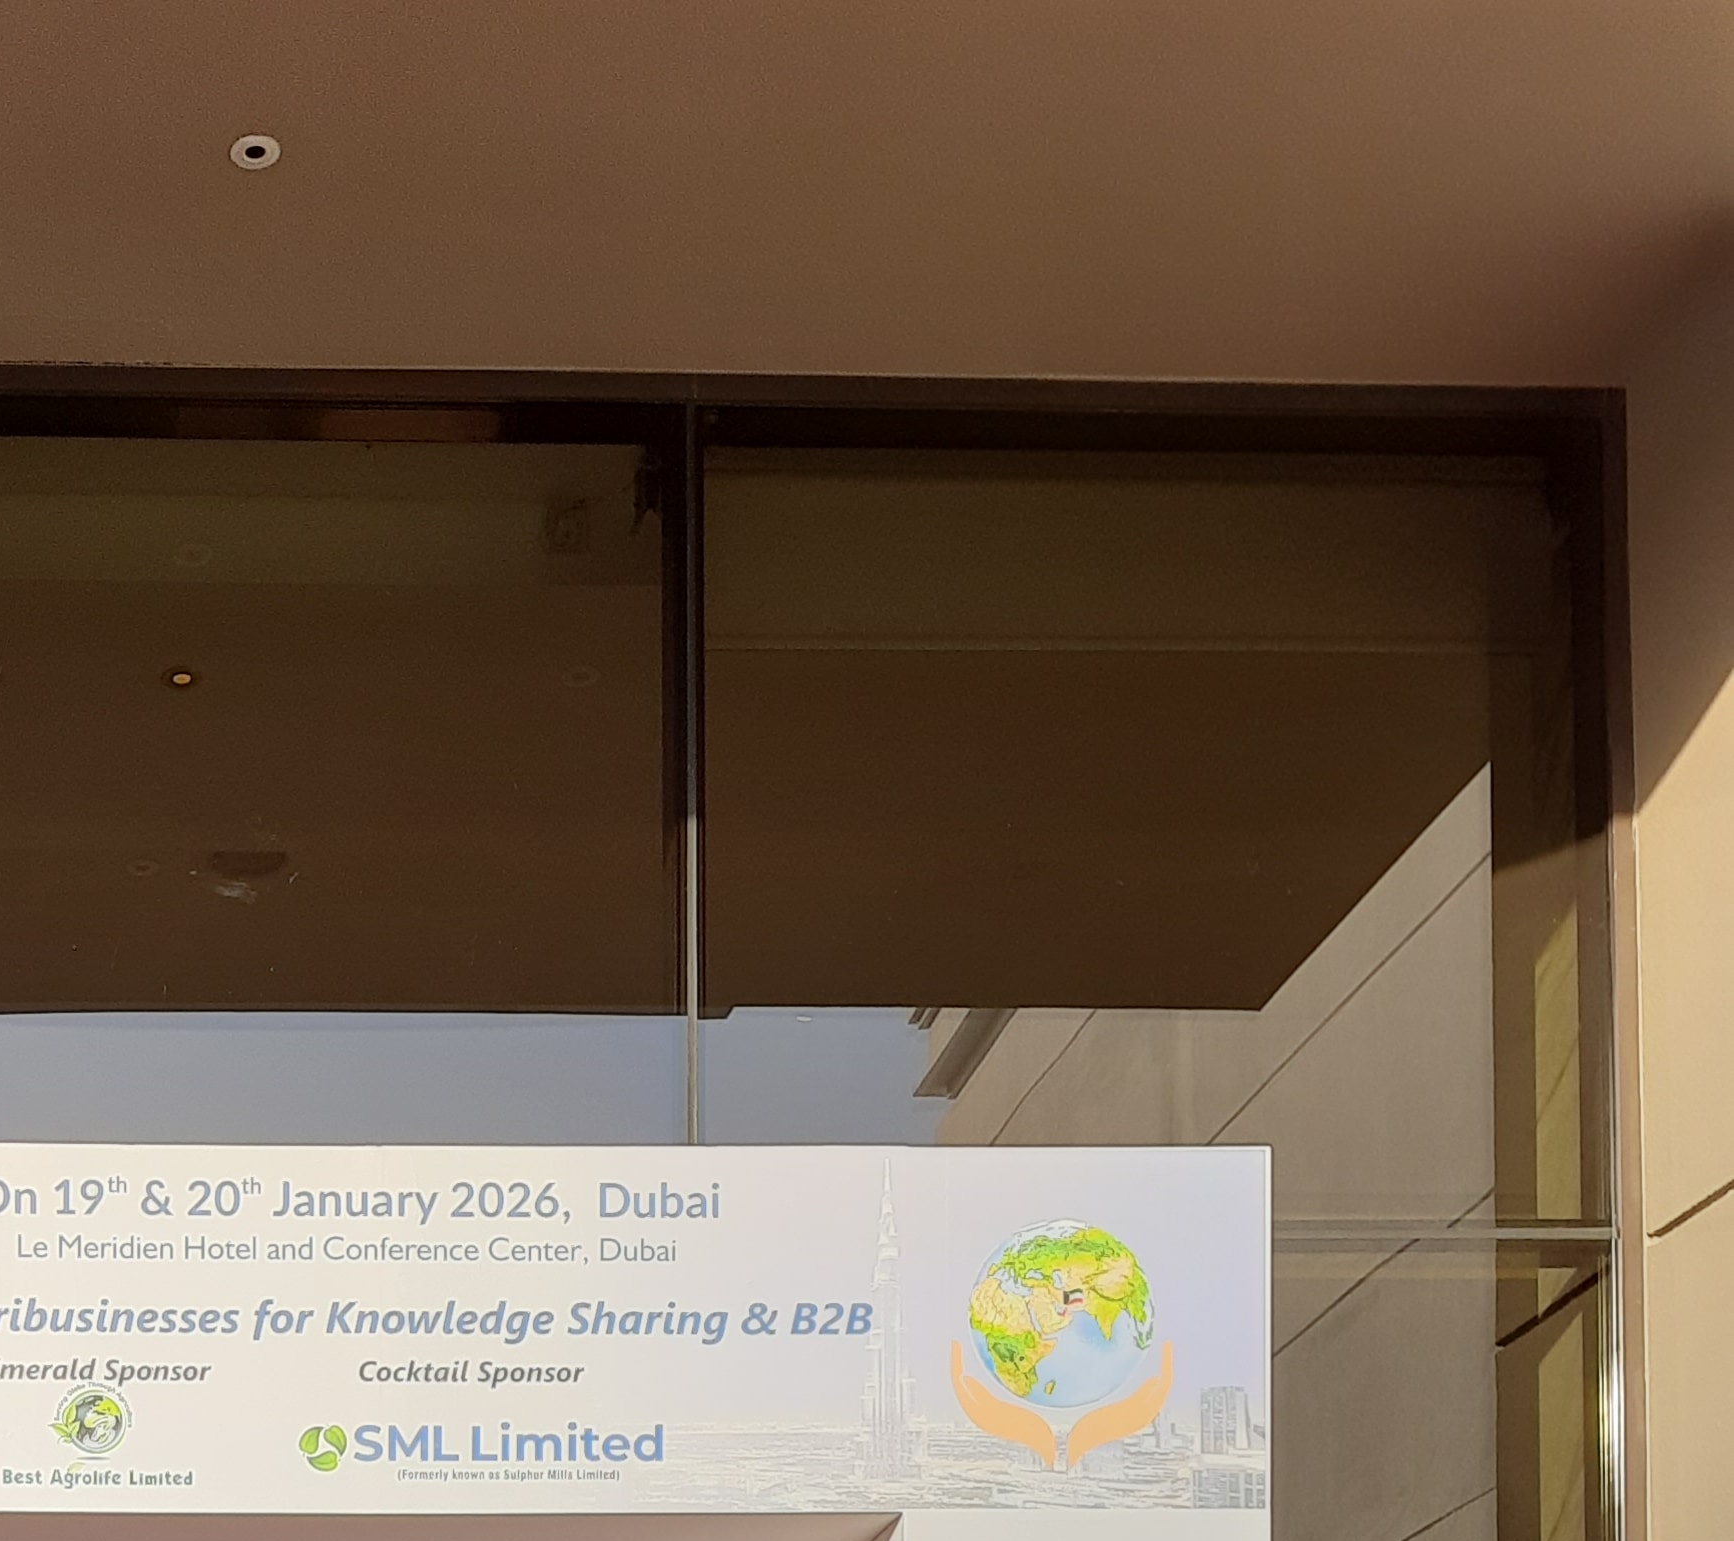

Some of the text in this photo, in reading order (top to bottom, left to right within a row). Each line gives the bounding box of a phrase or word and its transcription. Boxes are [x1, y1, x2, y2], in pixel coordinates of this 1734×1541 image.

[55, 1176, 126, 1214] 19th
[141, 1180, 173, 1215] &
[188, 1177, 261, 1216] 20th
[273, 1181, 438, 1225] January
[451, 1182, 570, 1224] 2026,
[600, 1182, 719, 1218] Dubai
[18, 1234, 676, 1264] Le Meridien Hotel and Conference Center, Dubai
[253, 1299, 314, 1340] for
[326, 1301, 554, 1344] Knowledge
[568, 1301, 728, 1345] Sharing
[741, 1303, 778, 1335] &
[791, 1303, 873, 1335] B2B
[104, 1360, 211, 1386] Sponsor
[359, 1360, 584, 1388] Cocktail Sponsor
[354, 1422, 663, 1461] SML Limited
[3, 1468, 192, 1489] Best Agrolife Limited
